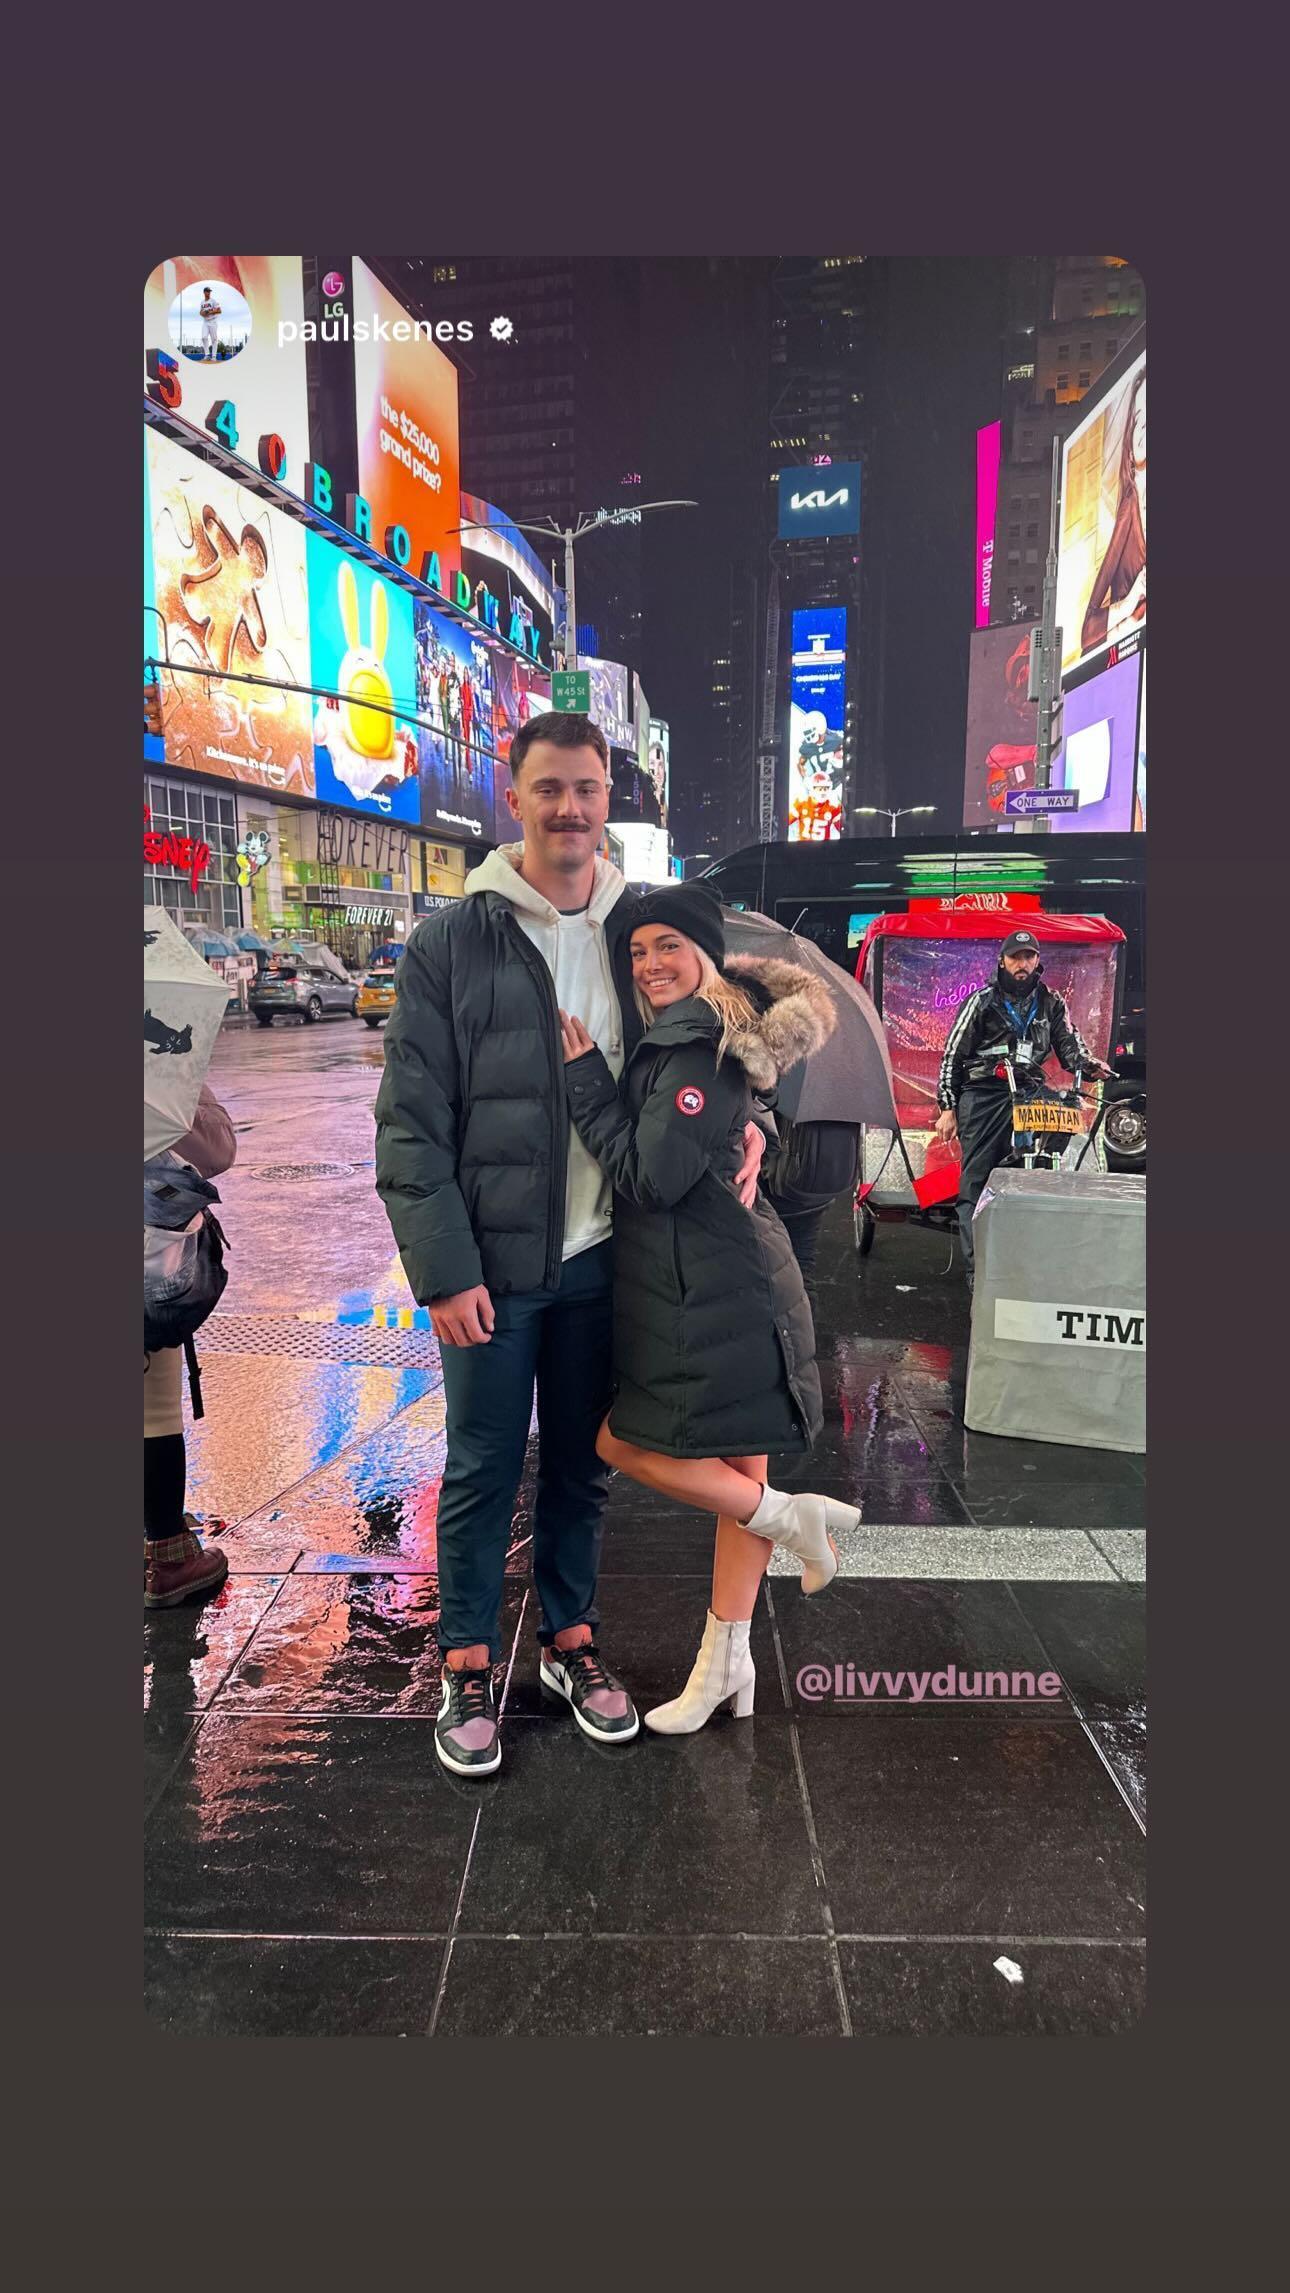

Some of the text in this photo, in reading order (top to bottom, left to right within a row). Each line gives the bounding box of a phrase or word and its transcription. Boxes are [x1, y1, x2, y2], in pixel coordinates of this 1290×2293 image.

[324, 302, 344, 318] LG
[381, 395, 399, 429] the
[380, 428, 442, 494] grand prize?
[565, 675, 576, 685] TO
[557, 687, 585, 696] W 45 St
[1016, 796, 1070, 808] ONE WAY
[316, 808, 408, 875] FOREVER
[345, 906, 382, 926] FOREVER
[1018, 1108, 1080, 1126] MANHATTAN
[1056, 1310, 1145, 1346] TIM
